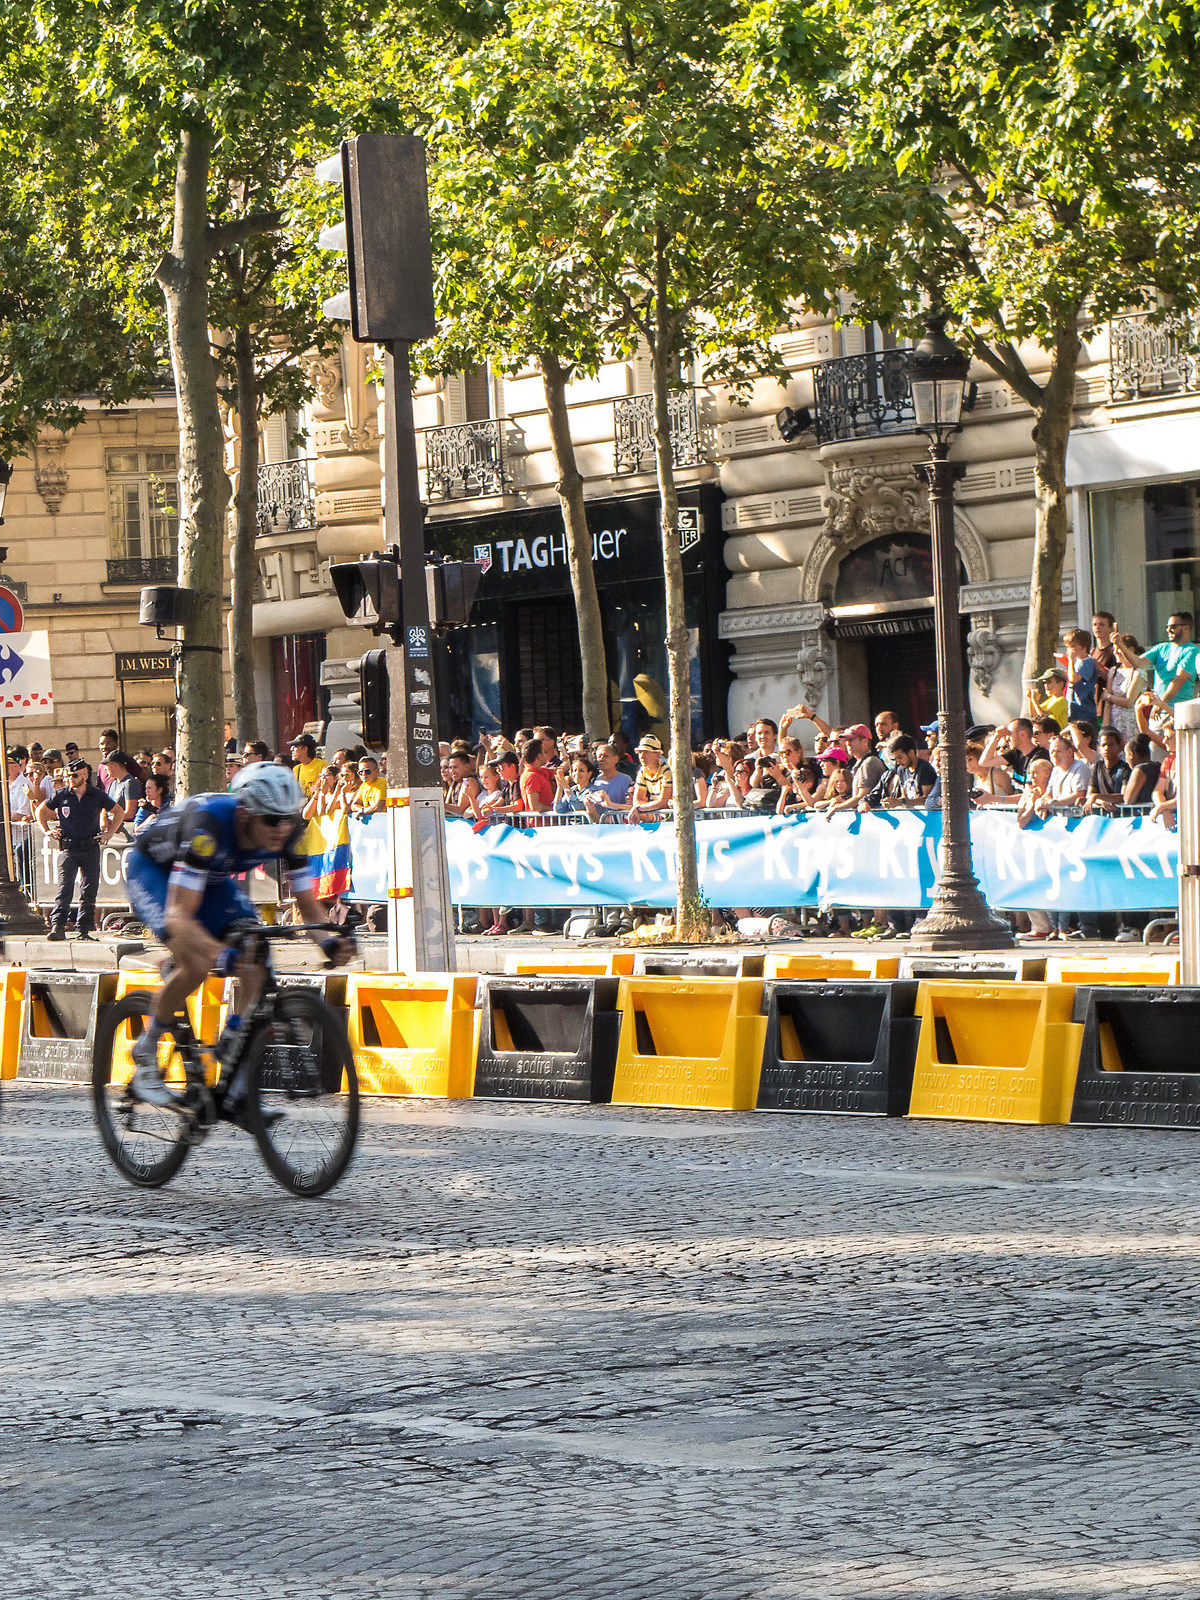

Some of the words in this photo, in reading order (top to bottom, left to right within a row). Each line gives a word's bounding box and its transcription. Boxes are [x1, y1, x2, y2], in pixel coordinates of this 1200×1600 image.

[496, 528, 627, 573] TAGHer
[877, 621, 899, 634] CLUB
[902, 619, 915, 632] DE
[140, 657, 172, 670] WEST
[762, 827, 856, 899] Krys
[994, 824, 1087, 900] Krys
